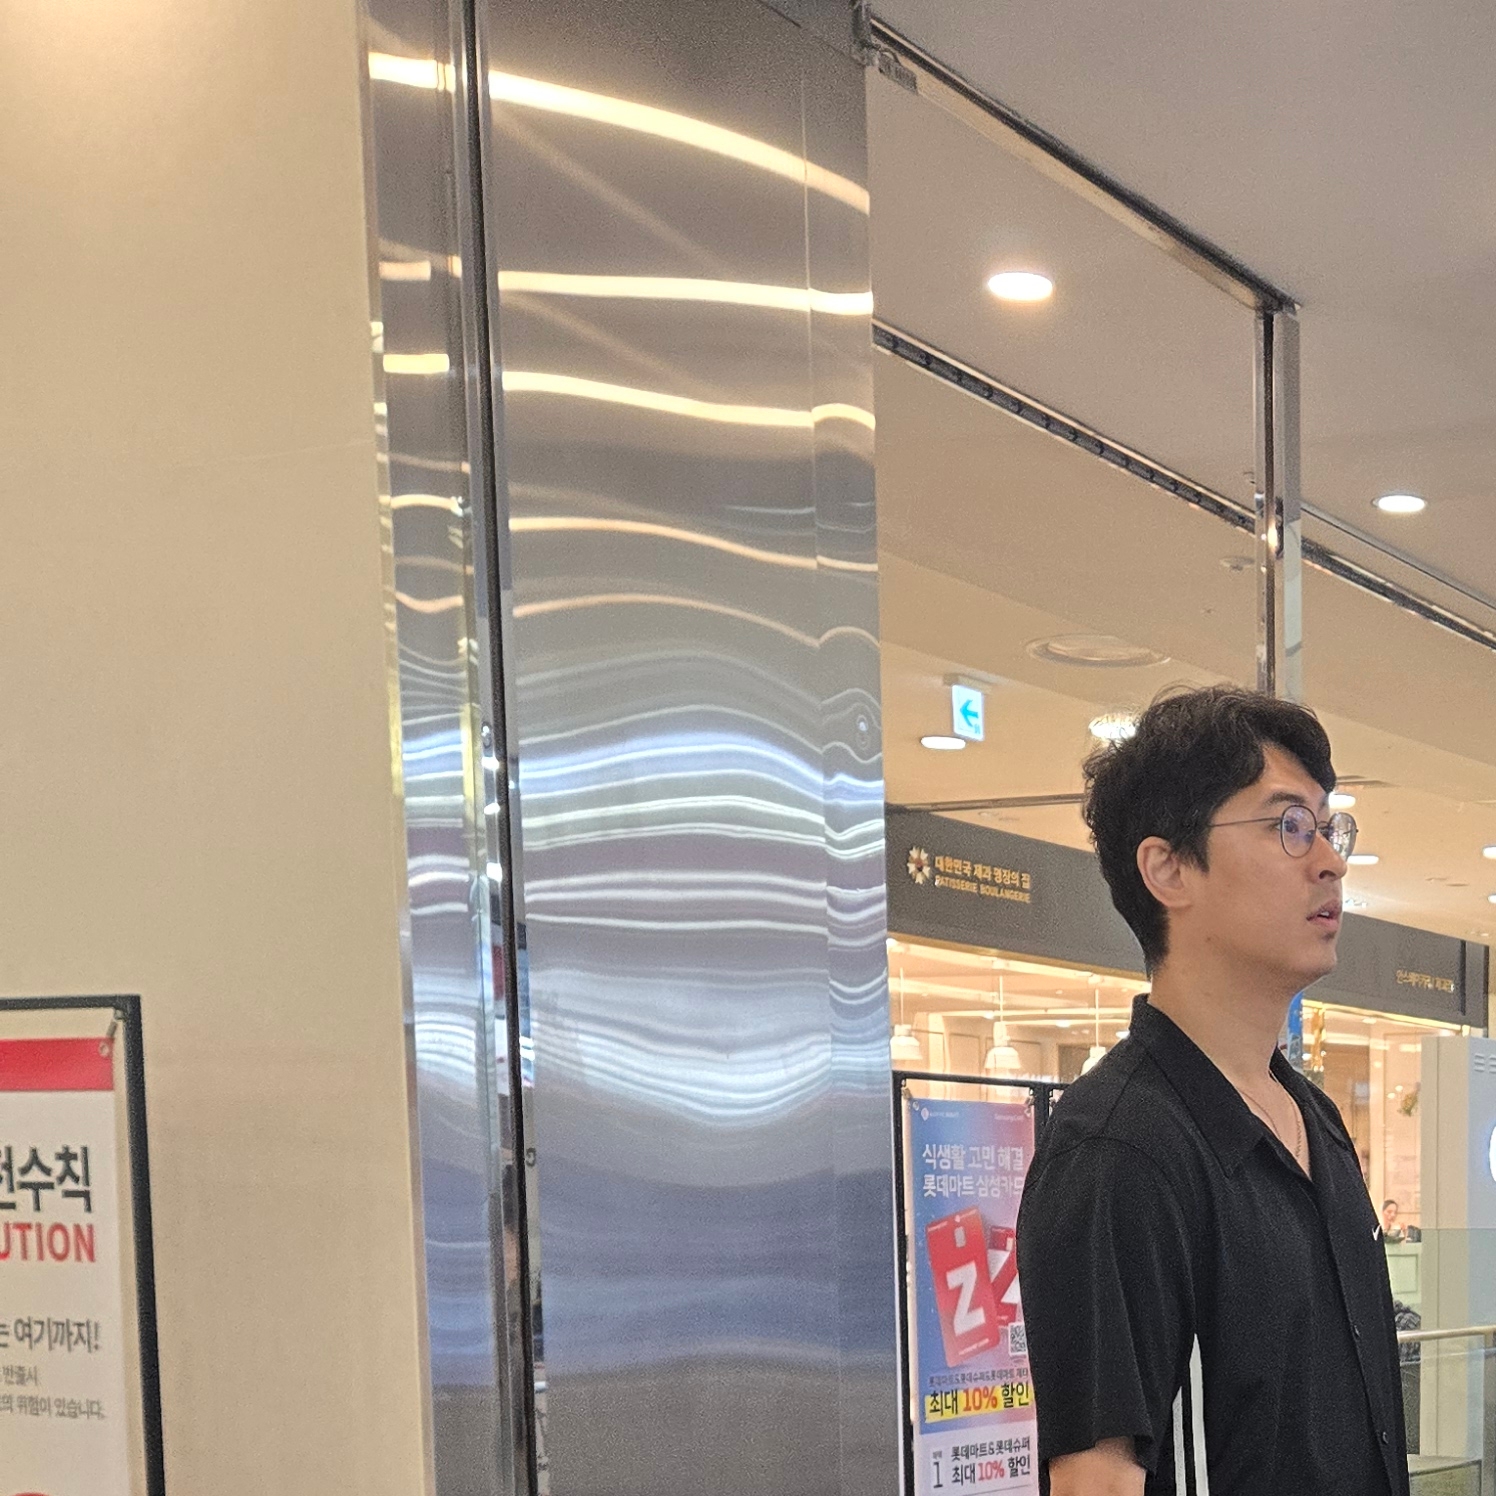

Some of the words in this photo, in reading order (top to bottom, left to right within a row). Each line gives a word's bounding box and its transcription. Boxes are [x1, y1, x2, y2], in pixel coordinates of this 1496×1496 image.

[935, 856, 971, 877] 대한민국
[922, 1144, 966, 1171] 식생활
[967, 1145, 995, 1171] 고민
[997, 1146, 1024, 1171] 해결
[923, 1174, 975, 1198] 롯데마트
[946, 1260, 986, 1336] Z
[14, 1316, 100, 1353] 여기까지!
[929, 1389, 959, 1417] 최대
[963, 1385, 998, 1412] 10%
[1001, 1381, 1030, 1409] 할인
[933, 1461, 943, 1488] 1
[951, 1463, 976, 1486] 최대
[978, 1460, 1005, 1482] 10%
[1007, 1454, 1031, 1478] 할인
